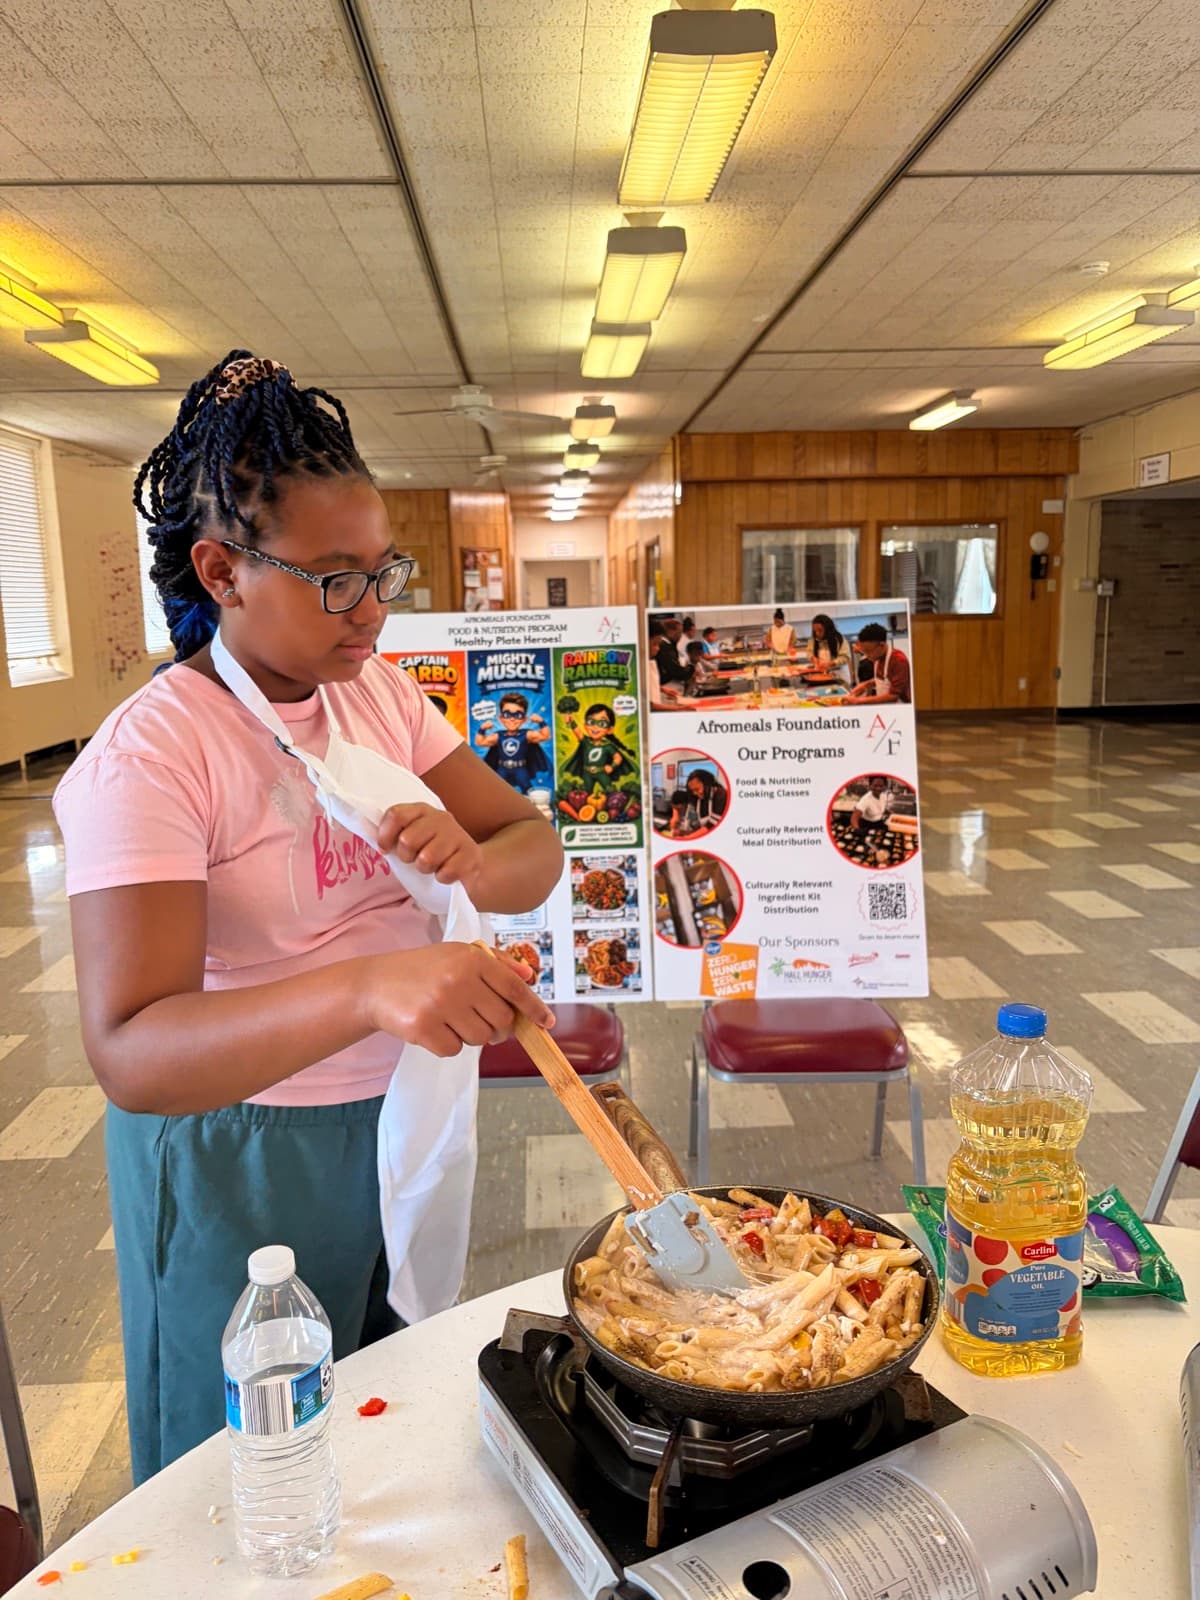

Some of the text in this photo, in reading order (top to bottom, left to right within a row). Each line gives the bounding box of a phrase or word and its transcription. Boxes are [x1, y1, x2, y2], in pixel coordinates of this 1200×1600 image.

[506, 613, 551, 623] FOUNDATION
[448, 627, 472, 636] FOOD
[480, 625, 526, 635] NUTRITION
[528, 624, 568, 633] PROGRAM
[454, 633, 562, 648] Healthy Plate Heroes!
[398, 655, 450, 669] CAPTAIN
[486, 653, 537, 666] MIGHTY
[563, 651, 631, 667] RAINBOW
[407, 665, 459, 683] ARBO
[477, 664, 546, 684] MUSCLE
[563, 664, 629, 681] RANGER
[697, 716, 860, 734] Afromeals Foundation
[738, 745, 845, 763] Our Programs
[736, 775, 811, 786] Food & Nutrition
[738, 788, 810, 799] Cooking Classes
[736, 825, 824, 836] Culturally Relevant
[742, 837, 822, 847] Meal Distribution
[745, 880, 832, 891] Culturally Relevant
[758, 892, 821, 904] Ingredient Kit
[763, 905, 819, 914] Distribution
[758, 935, 840, 950] Our Sponsors
[706, 953, 738, 968] ZERO
[709, 959, 757, 977] HUNGER
[802, 970, 832, 979] HUNGER
[714, 980, 756, 997] WASTE
[1024, 1245, 1055, 1257] Carlini
[1010, 1270, 1066, 1283] VEGETABLE
